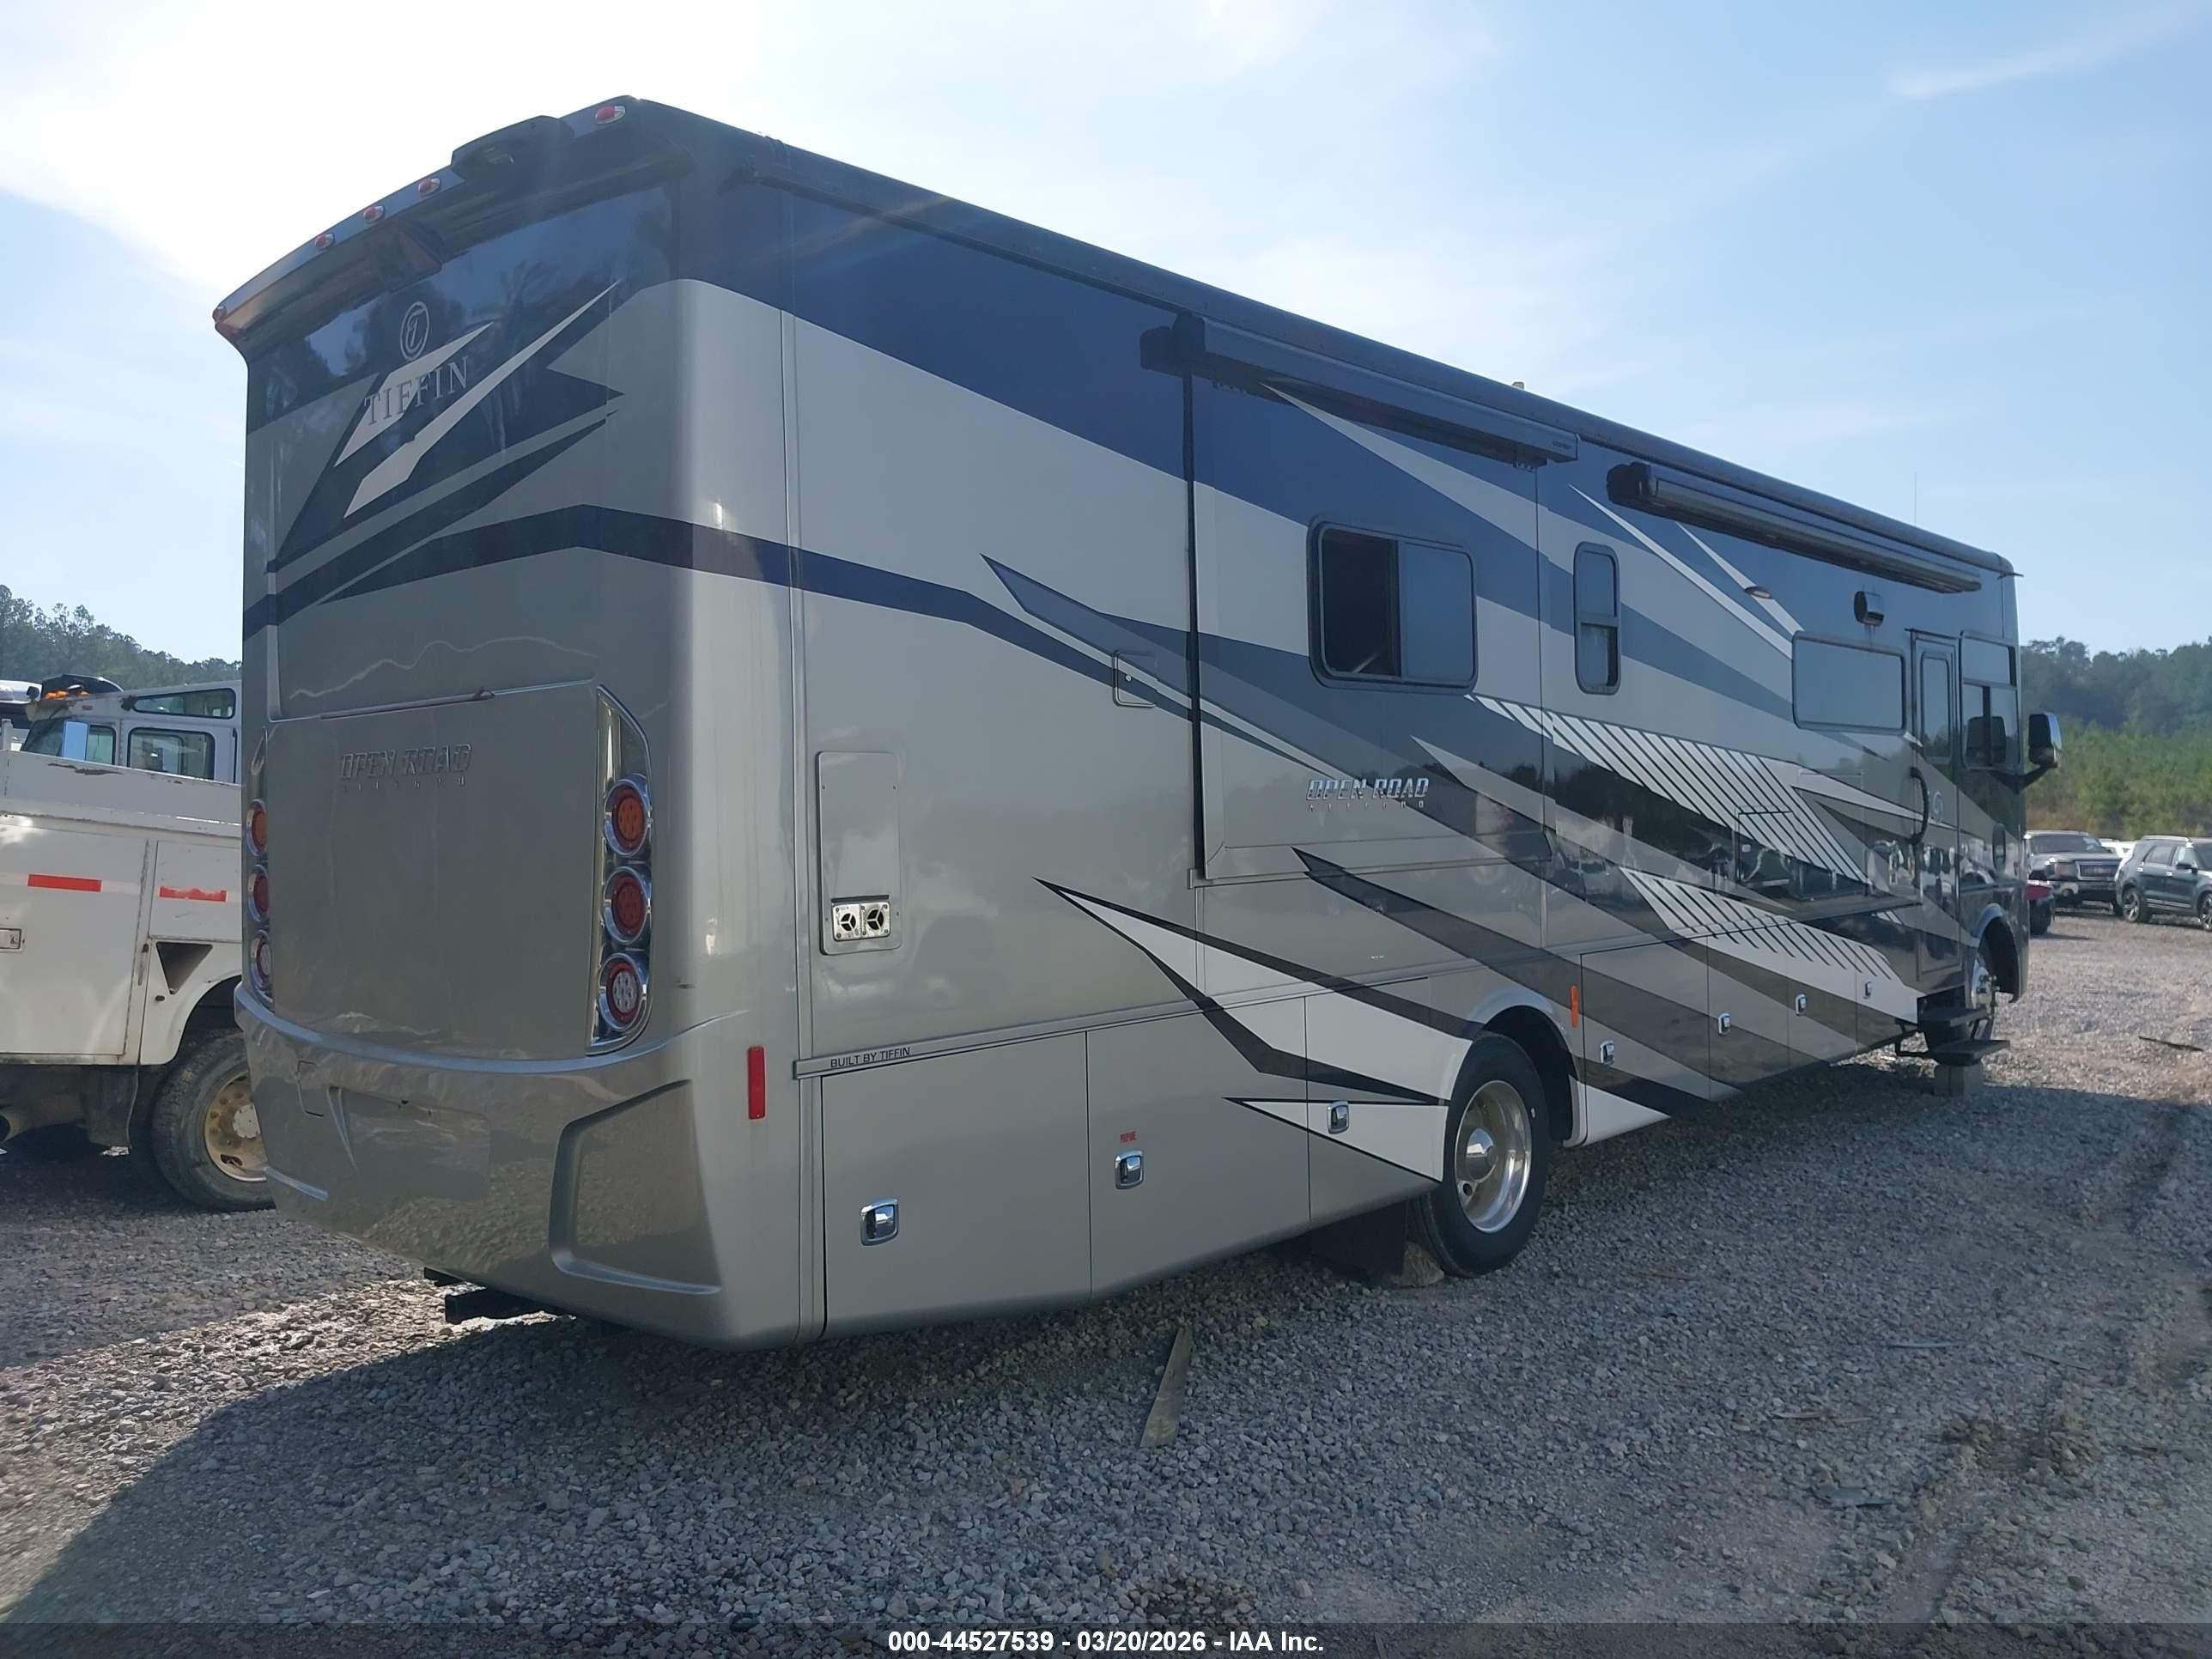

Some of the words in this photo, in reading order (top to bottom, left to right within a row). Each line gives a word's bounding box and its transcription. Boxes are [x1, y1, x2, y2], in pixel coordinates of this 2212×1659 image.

[363, 356, 470, 426] TIFFIN
[341, 749, 397, 781] OPEN
[402, 743, 472, 776] ROAD
[1305, 778, 1367, 800] OPEN
[1372, 777, 1430, 799] ROAD
[830, 1054, 860, 1068] BUILT
[863, 1052, 877, 1063] BY
[879, 1047, 910, 1060] TIFFIN
